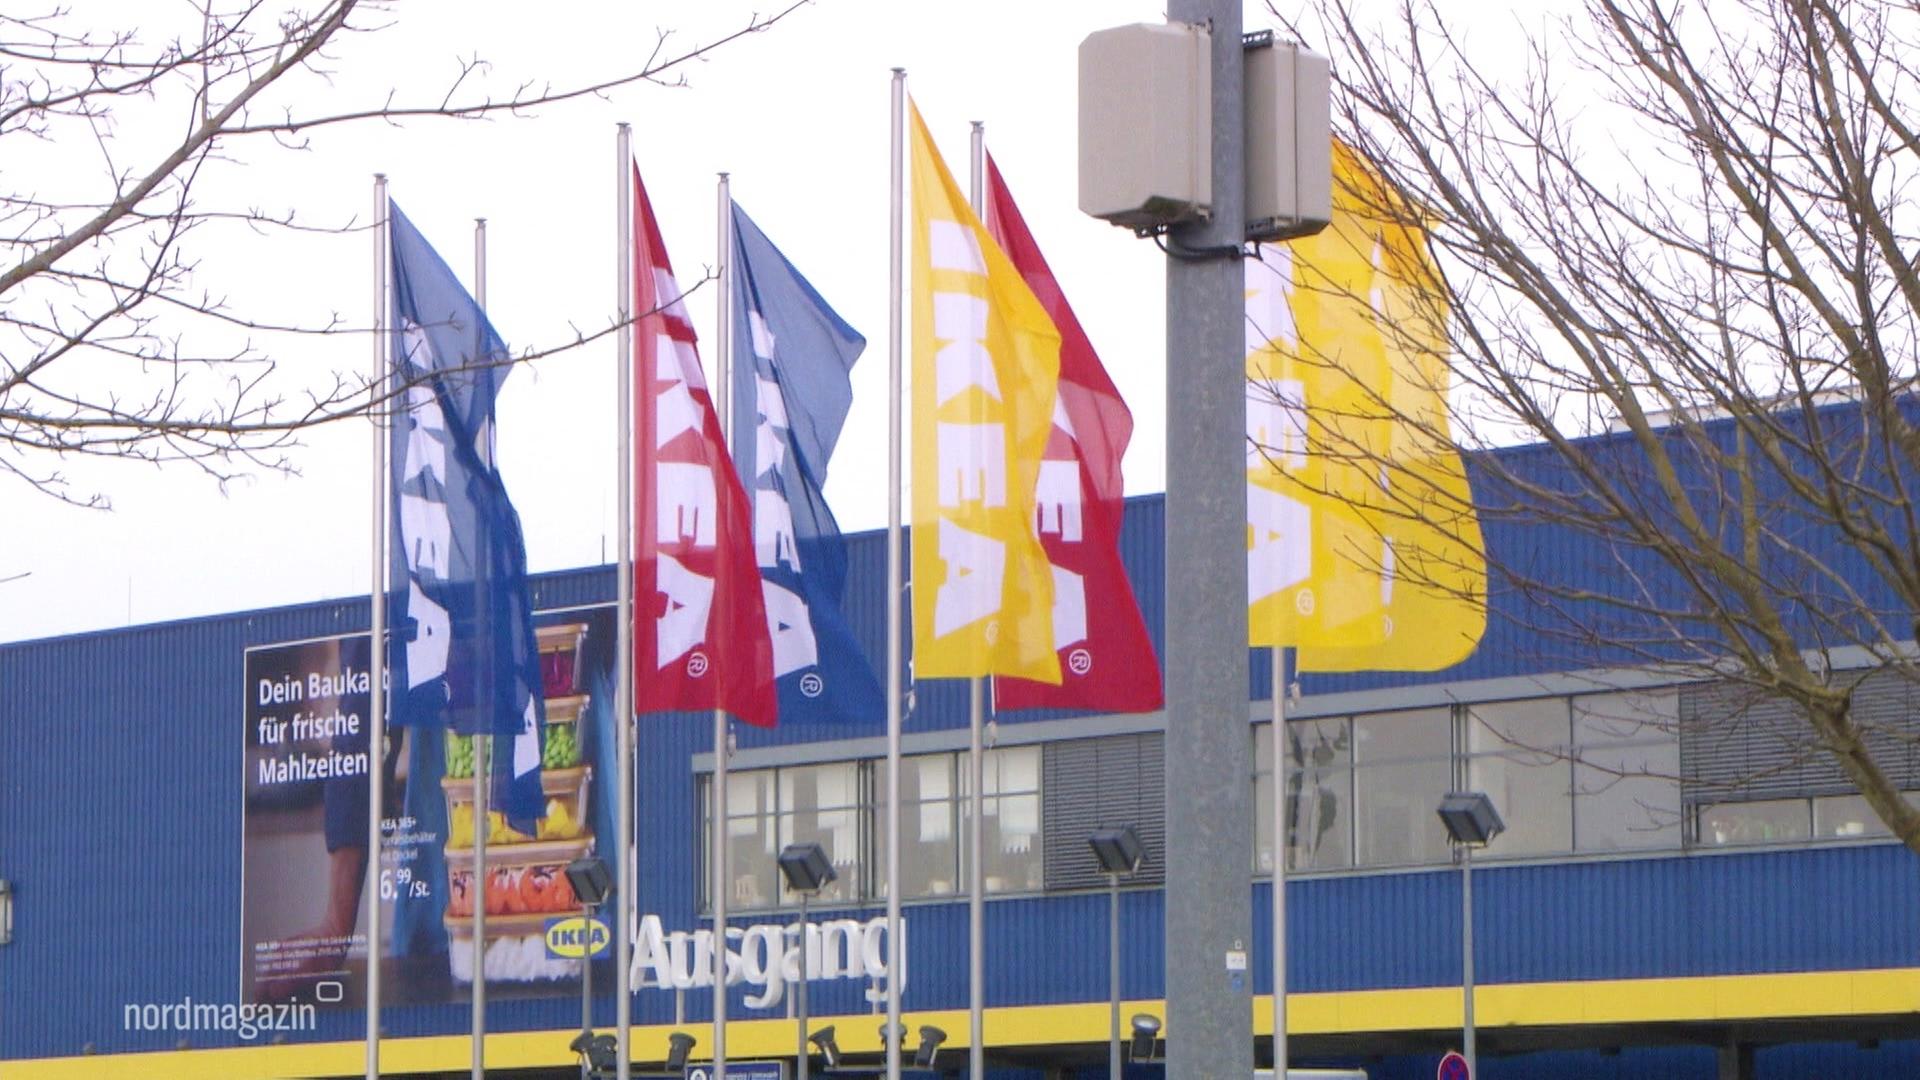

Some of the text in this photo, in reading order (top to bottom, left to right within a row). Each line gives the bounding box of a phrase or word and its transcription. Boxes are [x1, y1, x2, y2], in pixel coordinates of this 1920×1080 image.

[400, 316, 452, 691] IKEA
[653, 268, 718, 670] IKEA
[748, 311, 818, 679] IKEA
[929, 219, 1007, 640] IKEA
[1246, 240, 1312, 606] KEA
[259, 708, 360, 744] für frische
[259, 750, 368, 784] Mahlzeiten
[260, 674, 302, 705] Dein
[630, 914, 906, 1009] Ausgang
